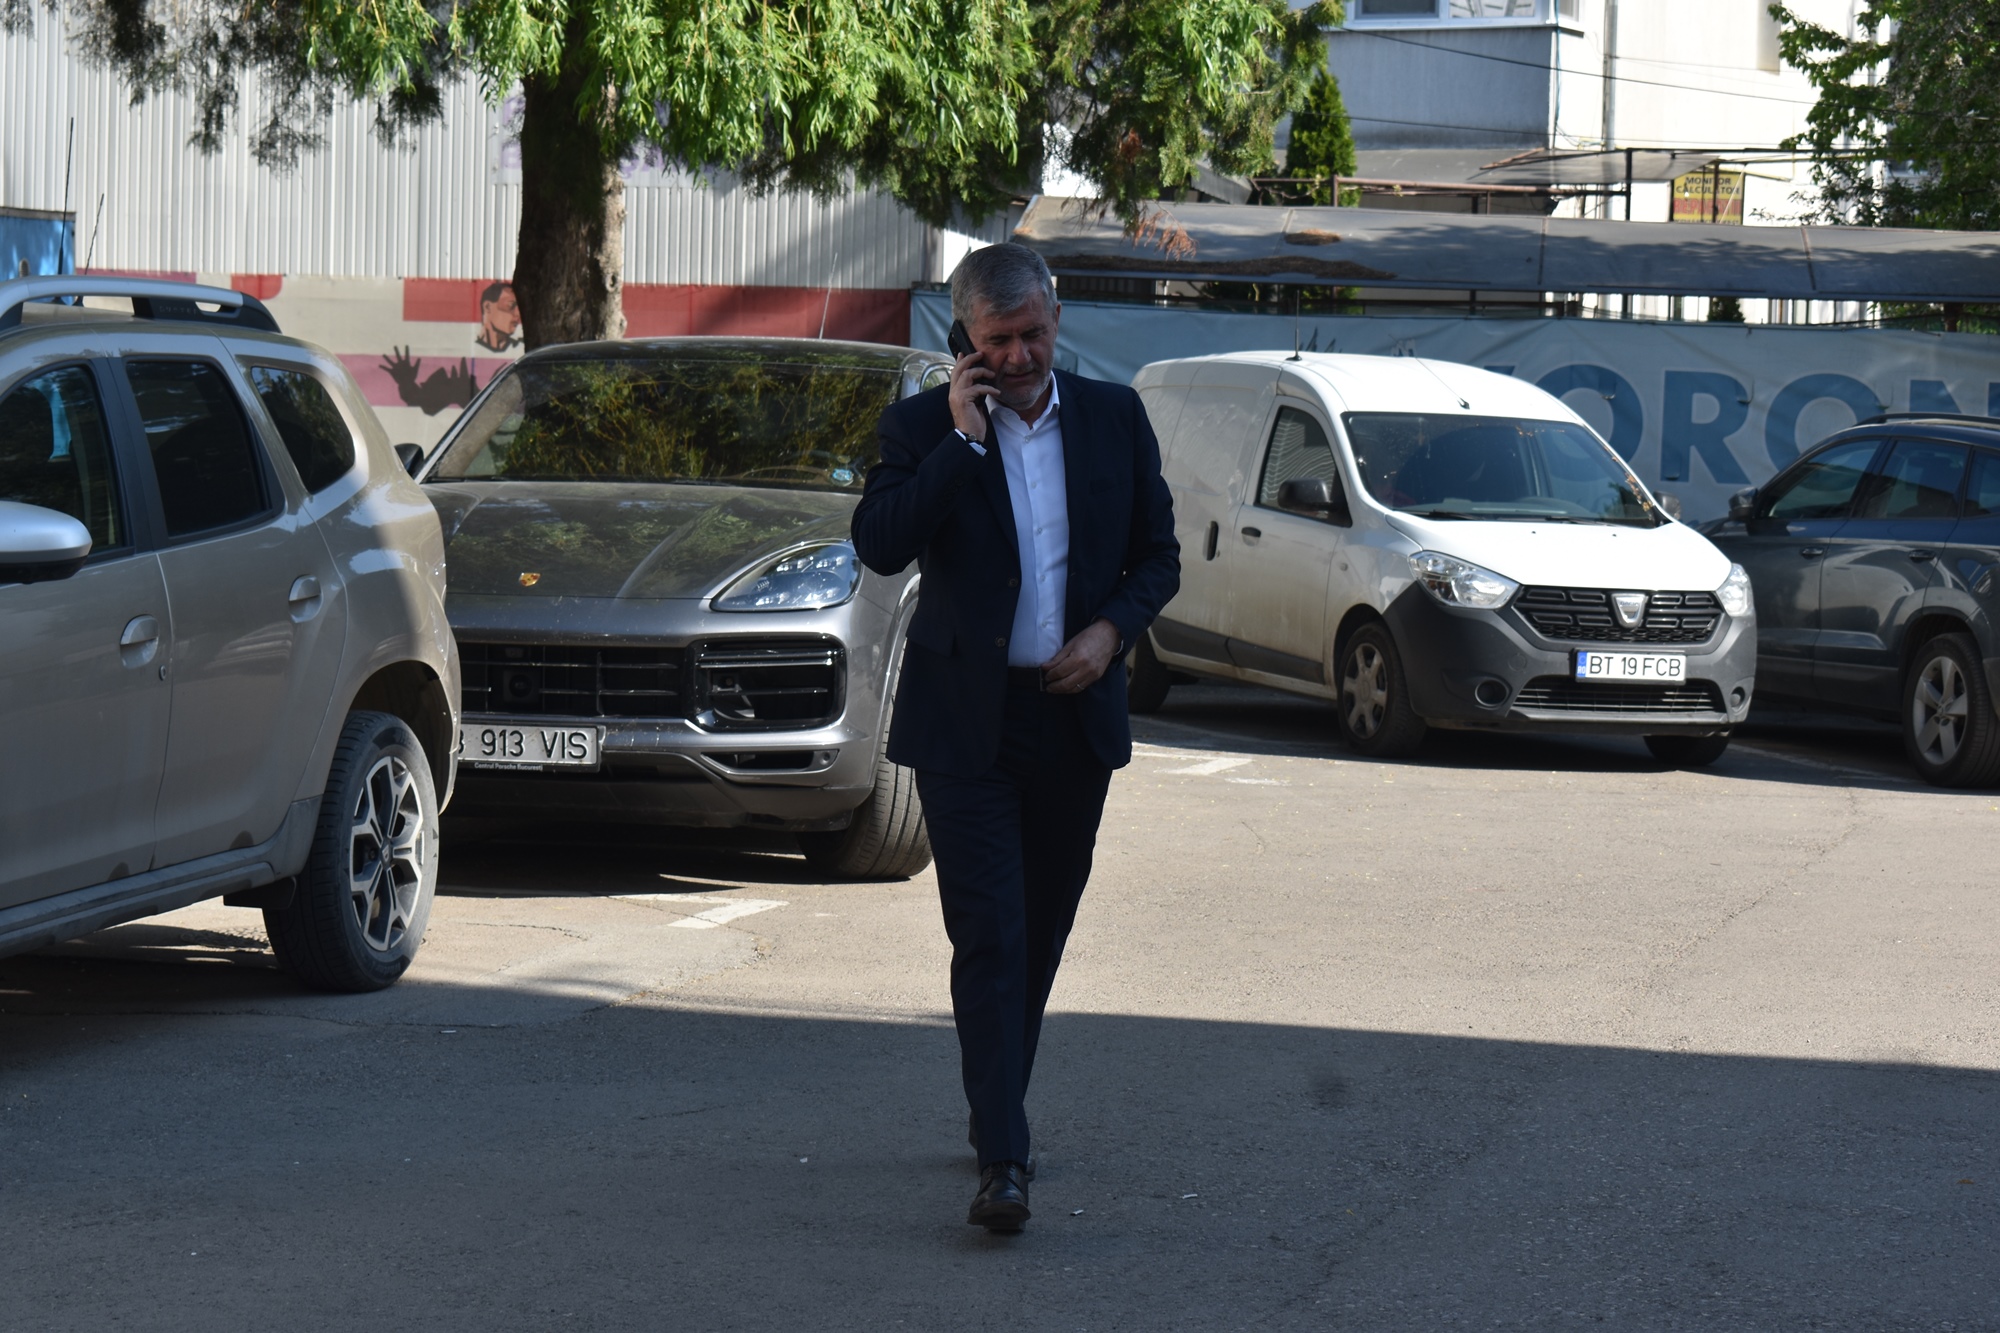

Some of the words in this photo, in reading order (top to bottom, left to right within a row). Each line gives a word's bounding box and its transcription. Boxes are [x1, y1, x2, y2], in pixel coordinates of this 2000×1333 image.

[1686, 176, 1731, 186] MONIOR
[1675, 186, 1740, 195] CALCULTOR
[1577, 665, 1586, 675] RO
[1589, 655, 1614, 675] BT
[1621, 656, 1638, 676] 19
[1642, 657, 1681, 677] FCB
[481, 728, 525, 757] 913
[540, 730, 588, 759] VIS
